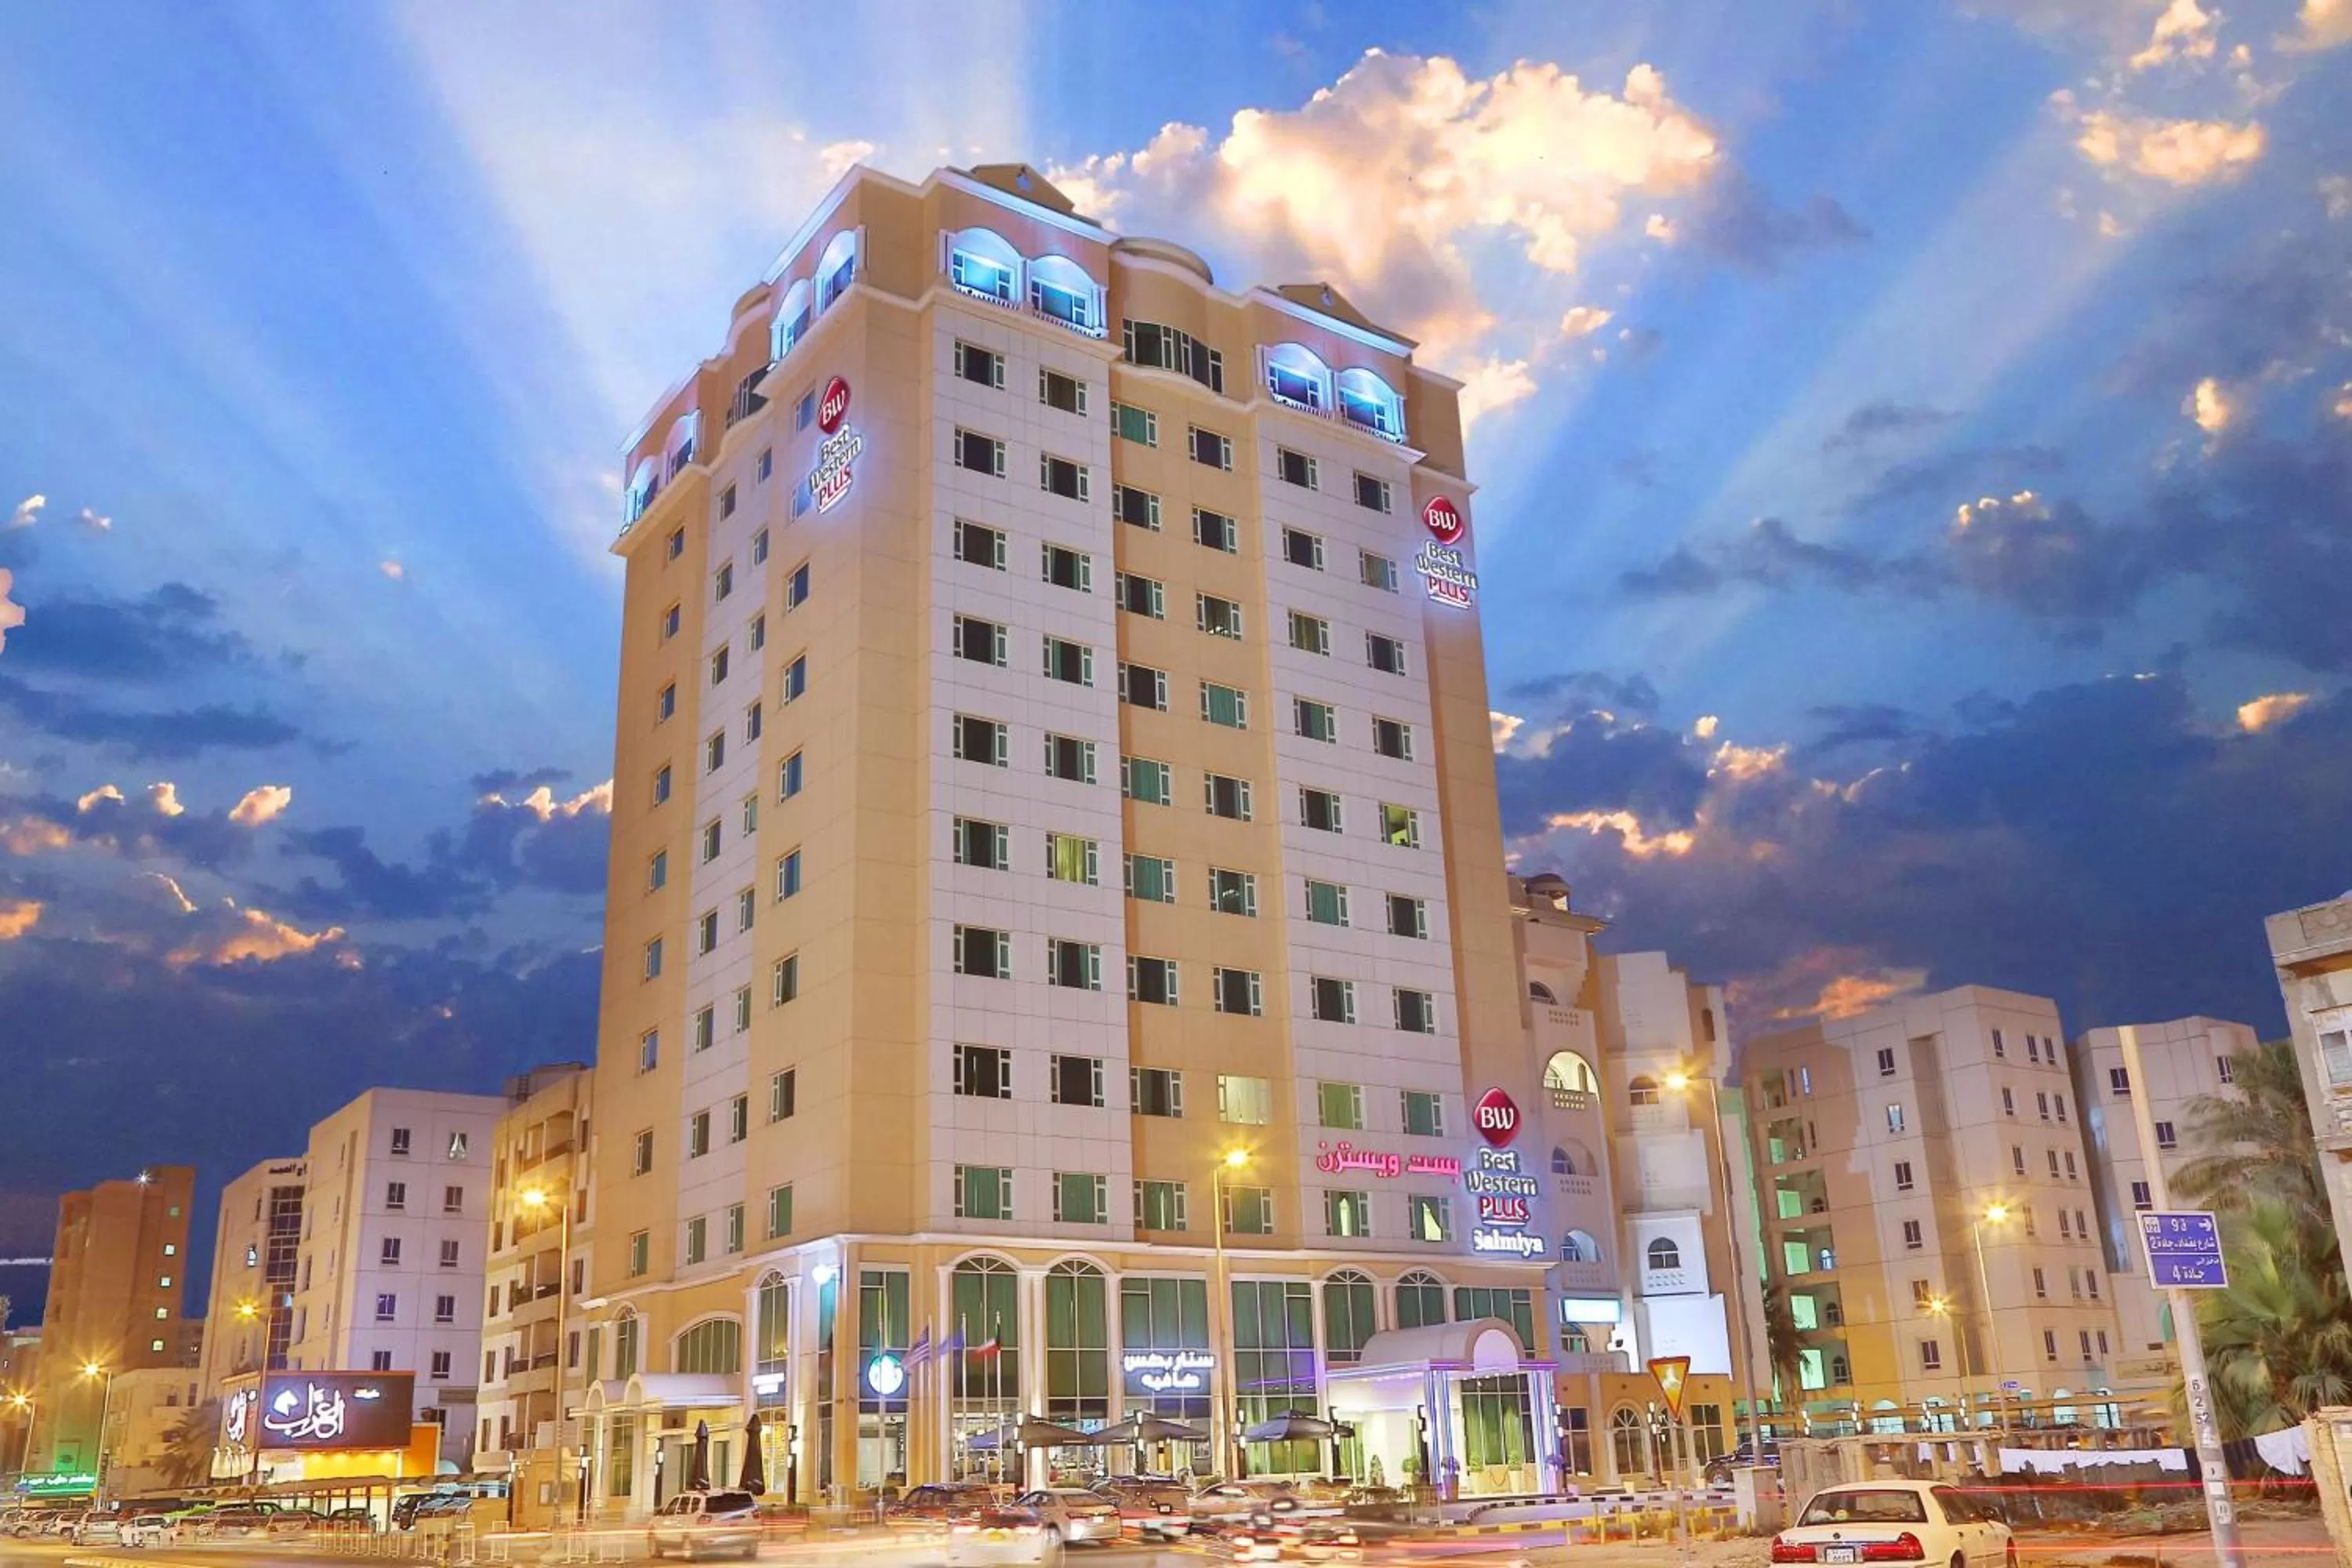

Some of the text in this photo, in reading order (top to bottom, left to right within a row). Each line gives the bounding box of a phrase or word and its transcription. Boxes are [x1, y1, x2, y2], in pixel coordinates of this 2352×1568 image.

[822, 389, 846, 426] BW
[820, 426, 850, 463] Best
[809, 437, 862, 494] Western
[818, 466, 852, 507] PLUS
[1428, 509, 1456, 531] BW
[1428, 541, 1463, 567] Best
[1416, 555, 1478, 590] Western
[1428, 576, 1468, 602] PLUS
[1481, 1106, 1514, 1130] BW
[1479, 1149, 1519, 1171] Best
[1465, 1171, 1538, 1196] Western
[1479, 1197, 1530, 1220] PLUS
[1472, 1229, 1544, 1257] Salmiya
[2172, 1265, 2182, 1281] 4
[2194, 1396, 2204, 1407] 2
